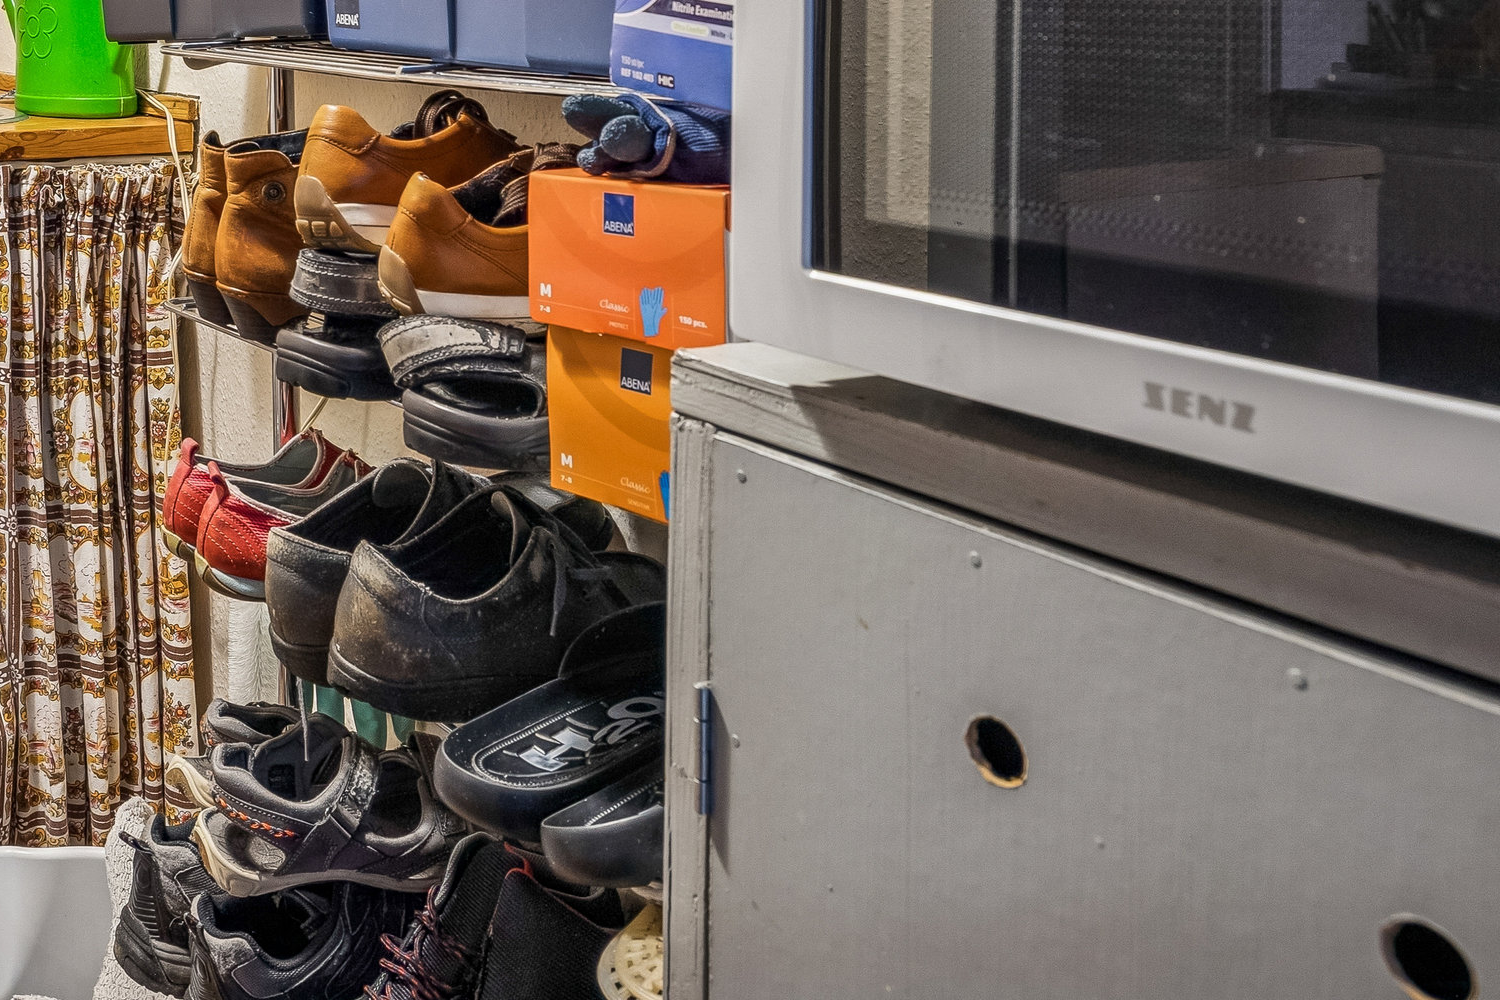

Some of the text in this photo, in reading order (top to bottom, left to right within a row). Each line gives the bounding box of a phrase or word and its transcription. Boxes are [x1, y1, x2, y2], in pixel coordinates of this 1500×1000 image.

[671, 1, 733, 21] Nitrile Examinati
[336, 13, 359, 26] ABENA
[711, 30, 726, 39] White
[604, 220, 633, 235] ABENA
[539, 282, 552, 298] M
[539, 304, 551, 313] 7-8
[599, 299, 630, 314] Classic
[620, 376, 650, 393] ABENA
[1142, 381, 1257, 434] SENZ
[560, 453, 573, 469] M
[560, 475, 573, 484] 7-8
[620, 477, 651, 494] Classic
